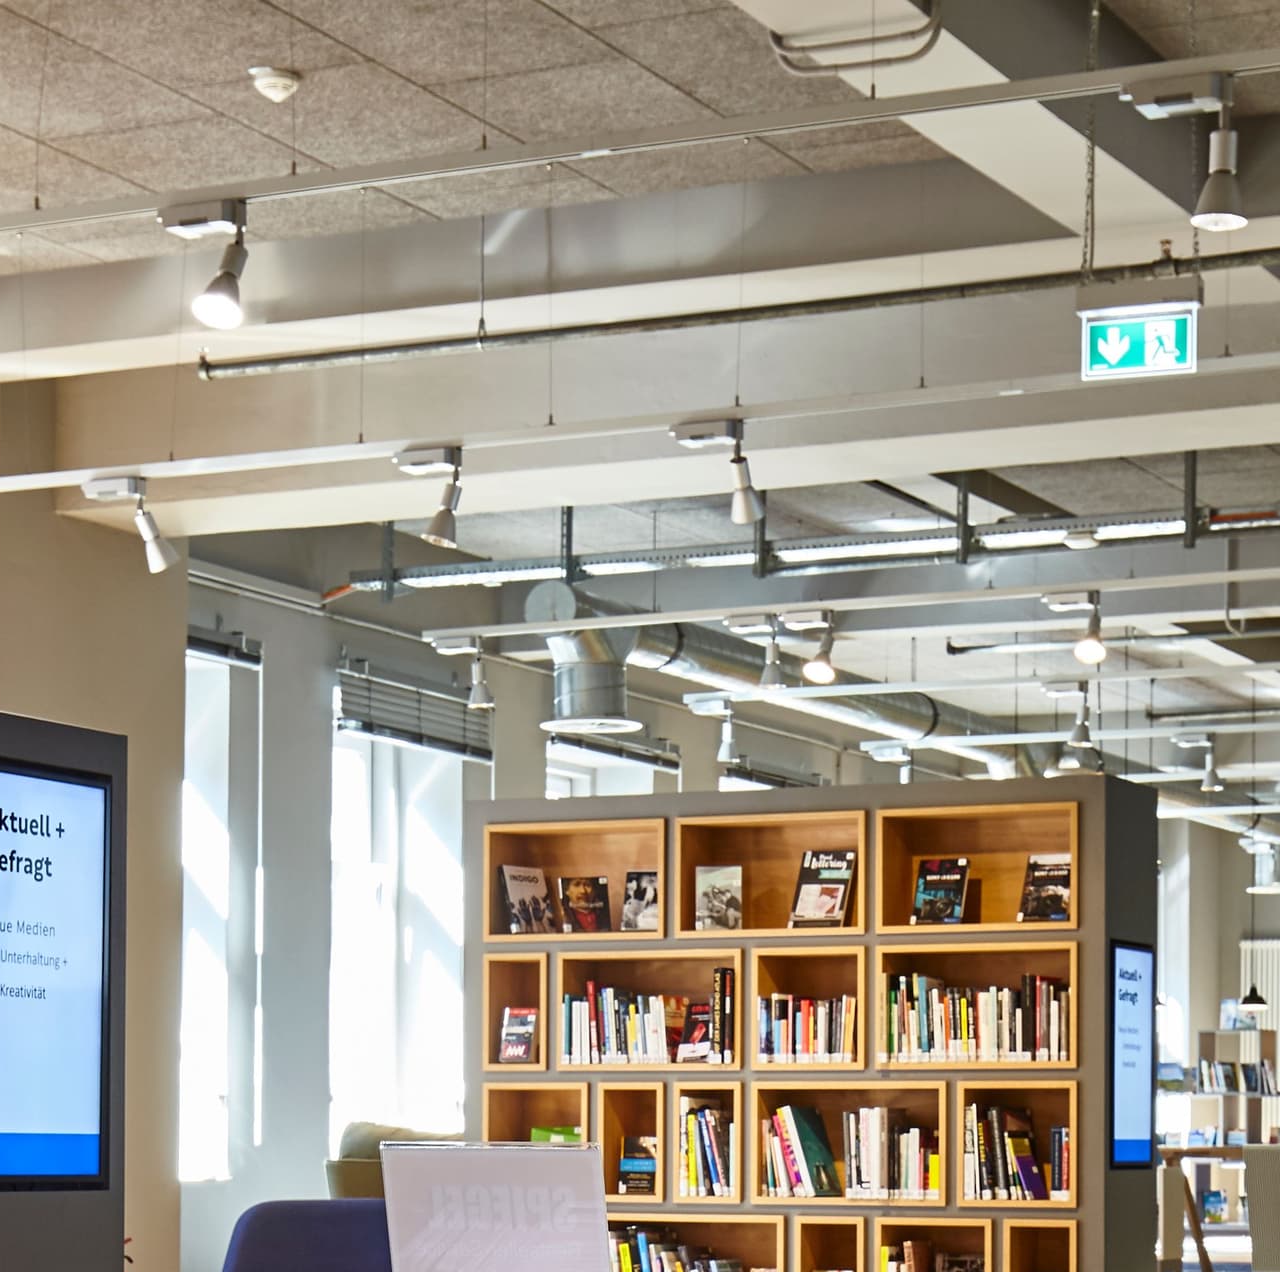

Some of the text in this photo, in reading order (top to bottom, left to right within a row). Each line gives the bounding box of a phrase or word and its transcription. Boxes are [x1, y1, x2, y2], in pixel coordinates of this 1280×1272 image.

[55, 822, 65, 839] +
[509, 875, 540, 885] INDIGO
[16, 920, 55, 938] Medien
[0, 949, 60, 970] Unterhaltung
[0, 983, 46, 1000] Kreativität
